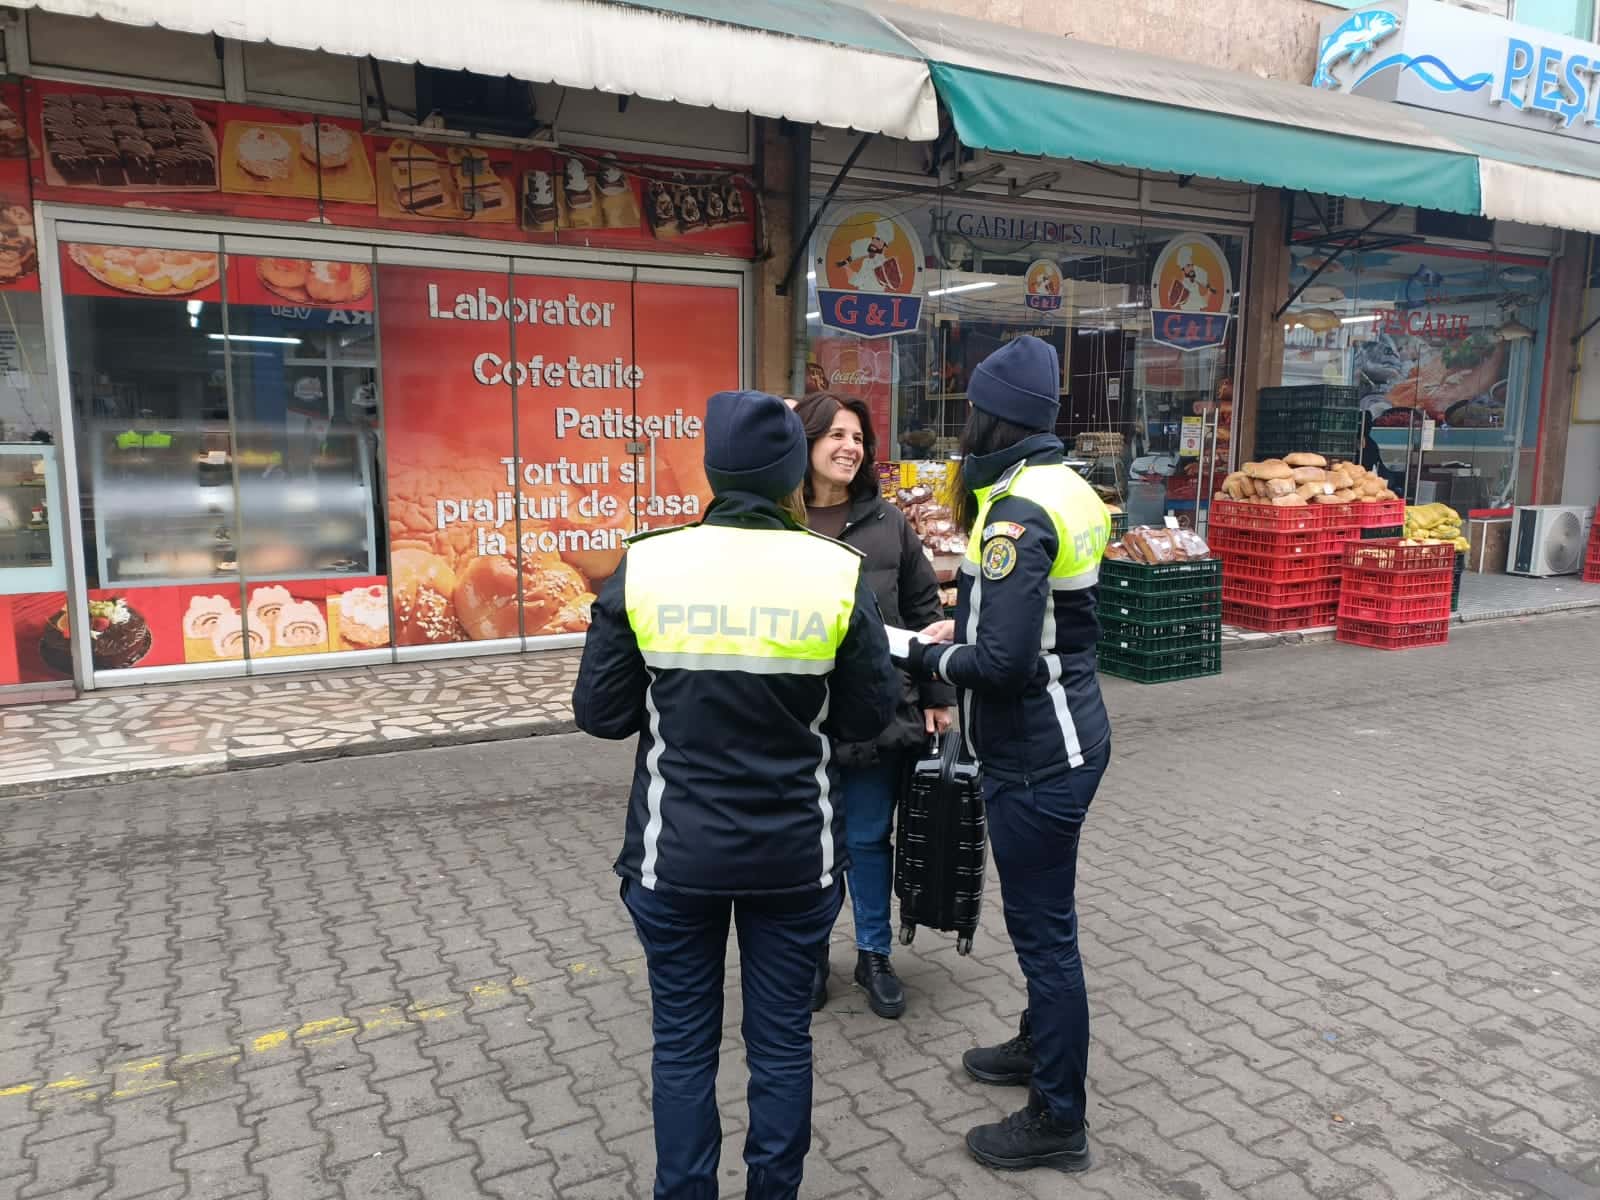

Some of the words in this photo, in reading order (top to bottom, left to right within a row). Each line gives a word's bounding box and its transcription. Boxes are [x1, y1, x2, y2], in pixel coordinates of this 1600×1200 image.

[1502, 38, 1600, 126] PEŞ
[428, 284, 615, 327] Laborator
[1371, 308, 1471, 340] PESCARIE
[473, 353, 645, 388] Cofetarie
[555, 407, 702, 439] Patiserie
[500, 457, 609, 486] Torturi
[619, 457, 646, 484] si
[436, 490, 569, 529] prajituri
[578, 489, 617, 517] de
[629, 493, 700, 517] casa
[478, 527, 507, 556] la
[656, 604, 829, 643] POLITIA
